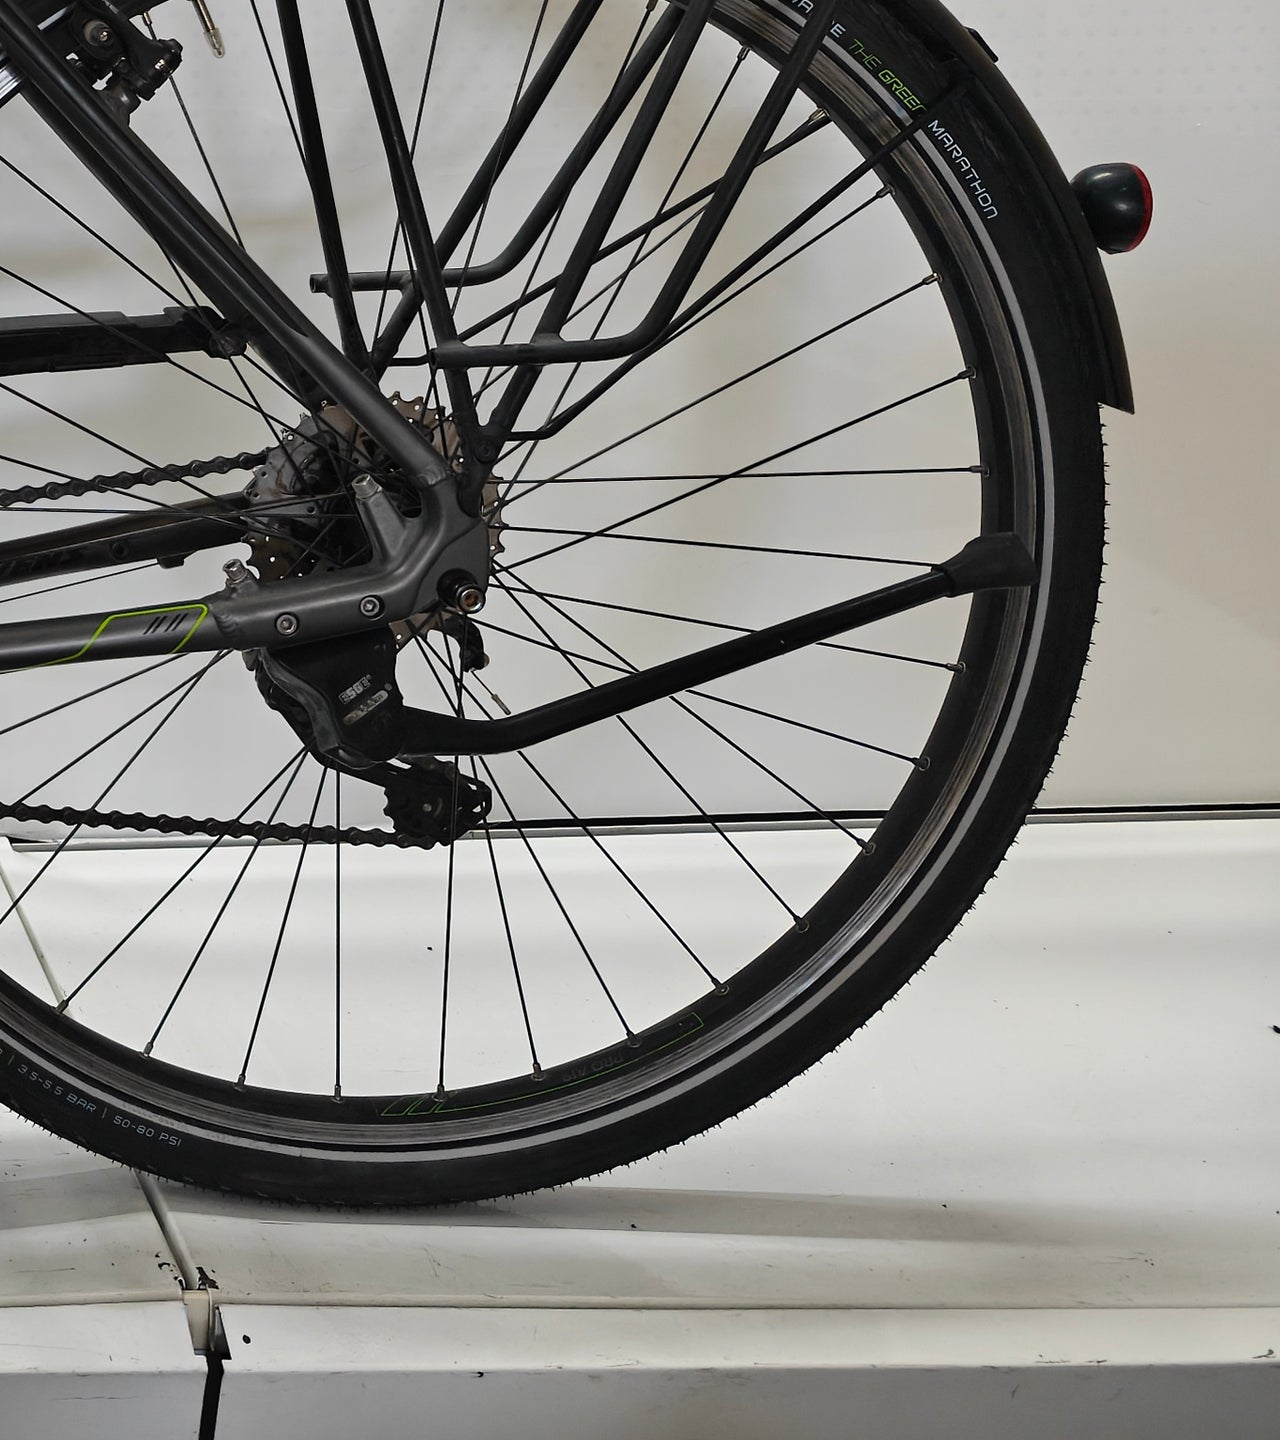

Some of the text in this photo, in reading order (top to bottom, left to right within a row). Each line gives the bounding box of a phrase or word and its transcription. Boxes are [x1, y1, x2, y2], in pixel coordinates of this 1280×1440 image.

[848, 38, 882, 71] THE
[927, 119, 999, 220] MARATHON
[66, 1091, 97, 1113] BAR
[113, 1115, 155, 1138] 50-80
[159, 1130, 182, 1148] PSI
